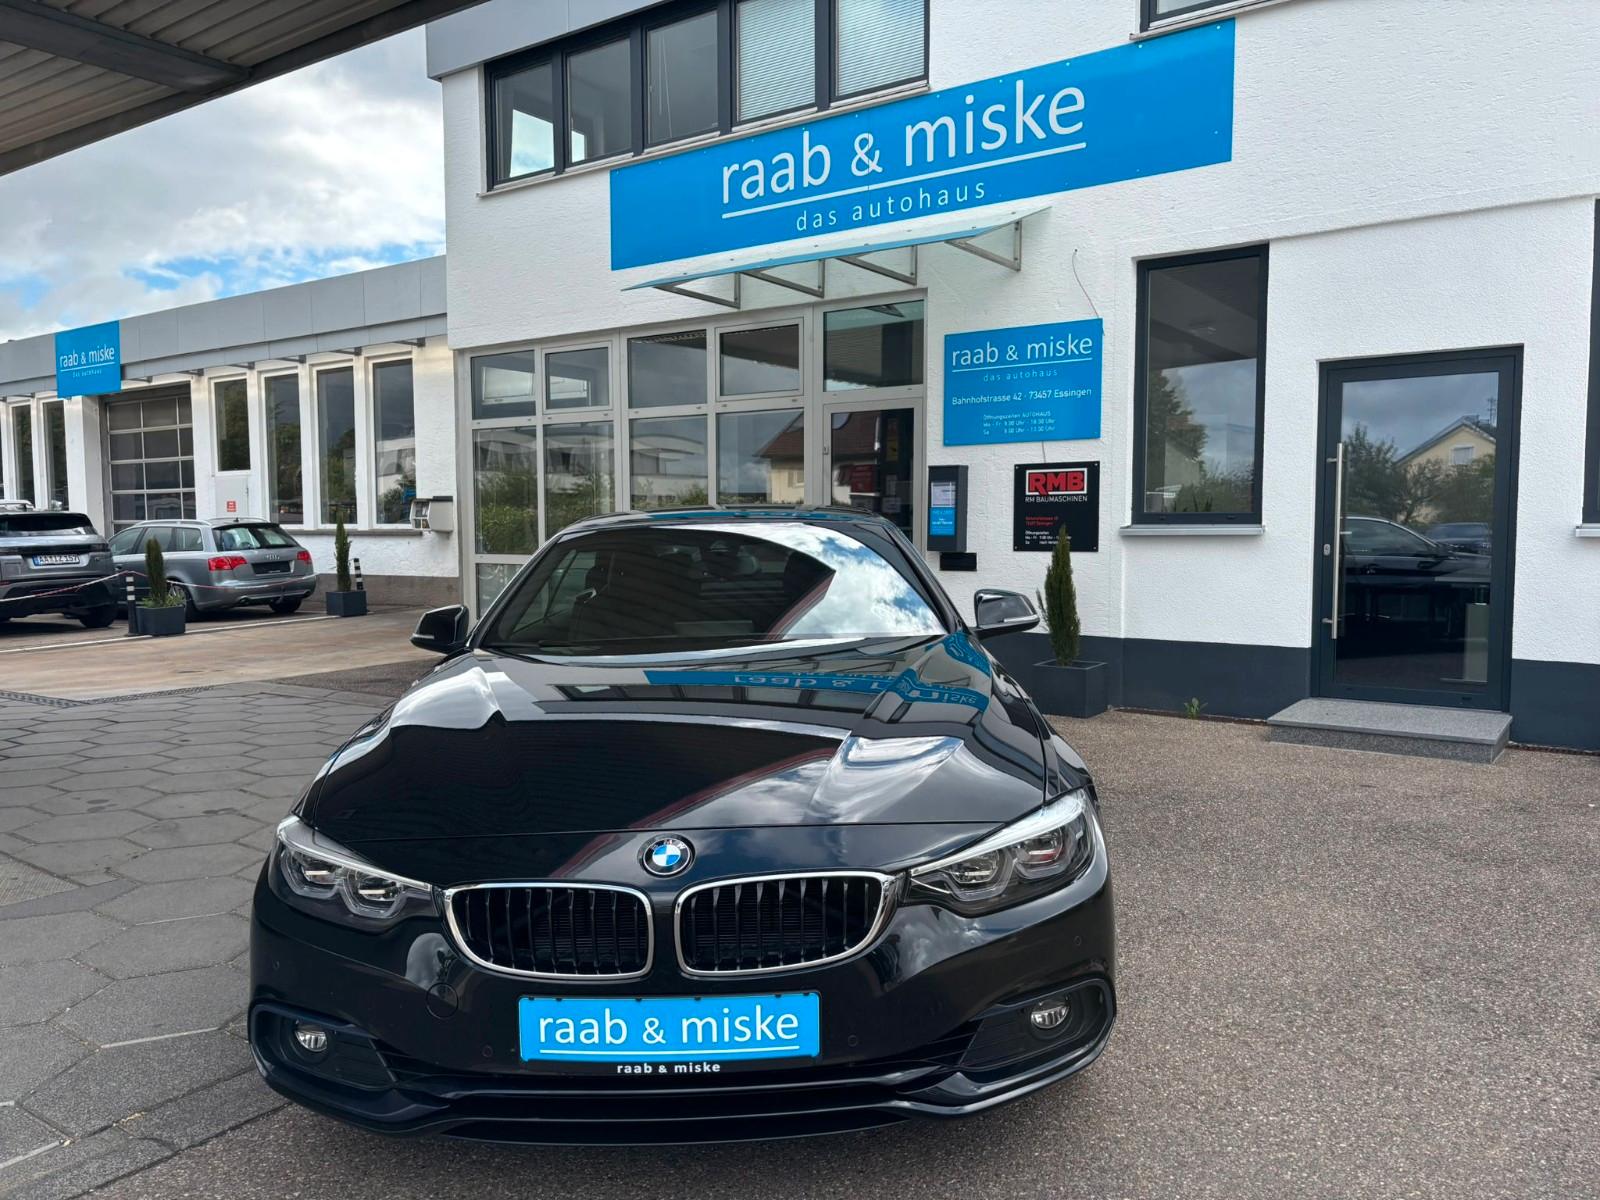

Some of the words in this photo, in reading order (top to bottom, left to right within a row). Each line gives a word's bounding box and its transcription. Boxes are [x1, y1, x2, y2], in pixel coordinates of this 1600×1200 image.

[722, 131, 831, 204] raab
[850, 132, 883, 178] &
[904, 80, 1086, 166] miske
[796, 207, 837, 232] das
[852, 180, 986, 222] autohaus
[60, 349, 79, 368] raab
[81, 351, 87, 365] &
[89, 344, 115, 363] miske
[952, 341, 999, 366] raab
[1006, 345, 1019, 361] &
[1027, 333, 1092, 359] miske
[984, 372, 1001, 382] das
[1006, 369, 1058, 380] autohaus
[952, 393, 1011, 405] Bahnhofstrasse
[1012, 393, 1022, 401] 42
[1028, 390, 1052, 400] 73457
[1054, 388, 1092, 399] Essingen
[1029, 471, 1085, 496] RMB
[539, 1007, 628, 1045] raab
[642, 1017, 667, 1045] &
[682, 1004, 800, 1044] miske
[616, 1062, 653, 1074] raab
[658, 1063, 668, 1074] &
[674, 1061, 721, 1074] miske
